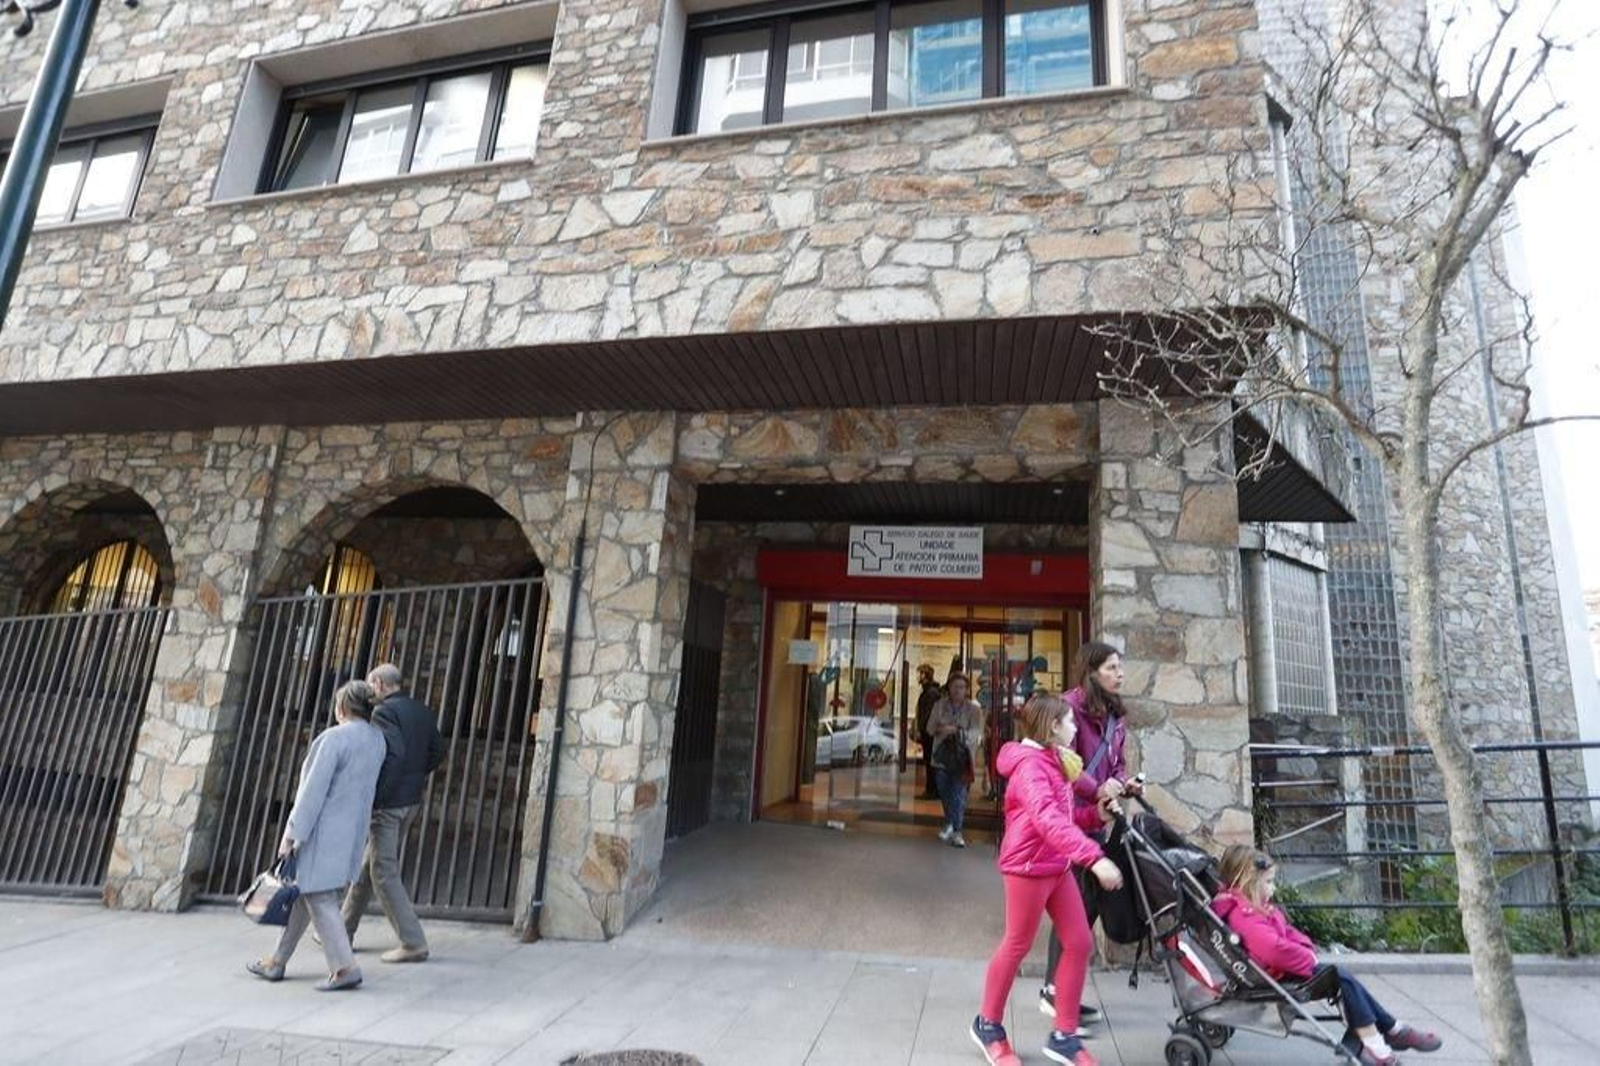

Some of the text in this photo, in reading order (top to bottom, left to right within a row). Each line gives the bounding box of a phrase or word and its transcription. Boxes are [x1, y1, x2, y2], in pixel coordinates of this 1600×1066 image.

[919, 540, 954, 550] UNIDADE
[938, 552, 979, 562] PRIMARIA
[893, 562, 980, 575] DE PINTOR COLMEIRO
